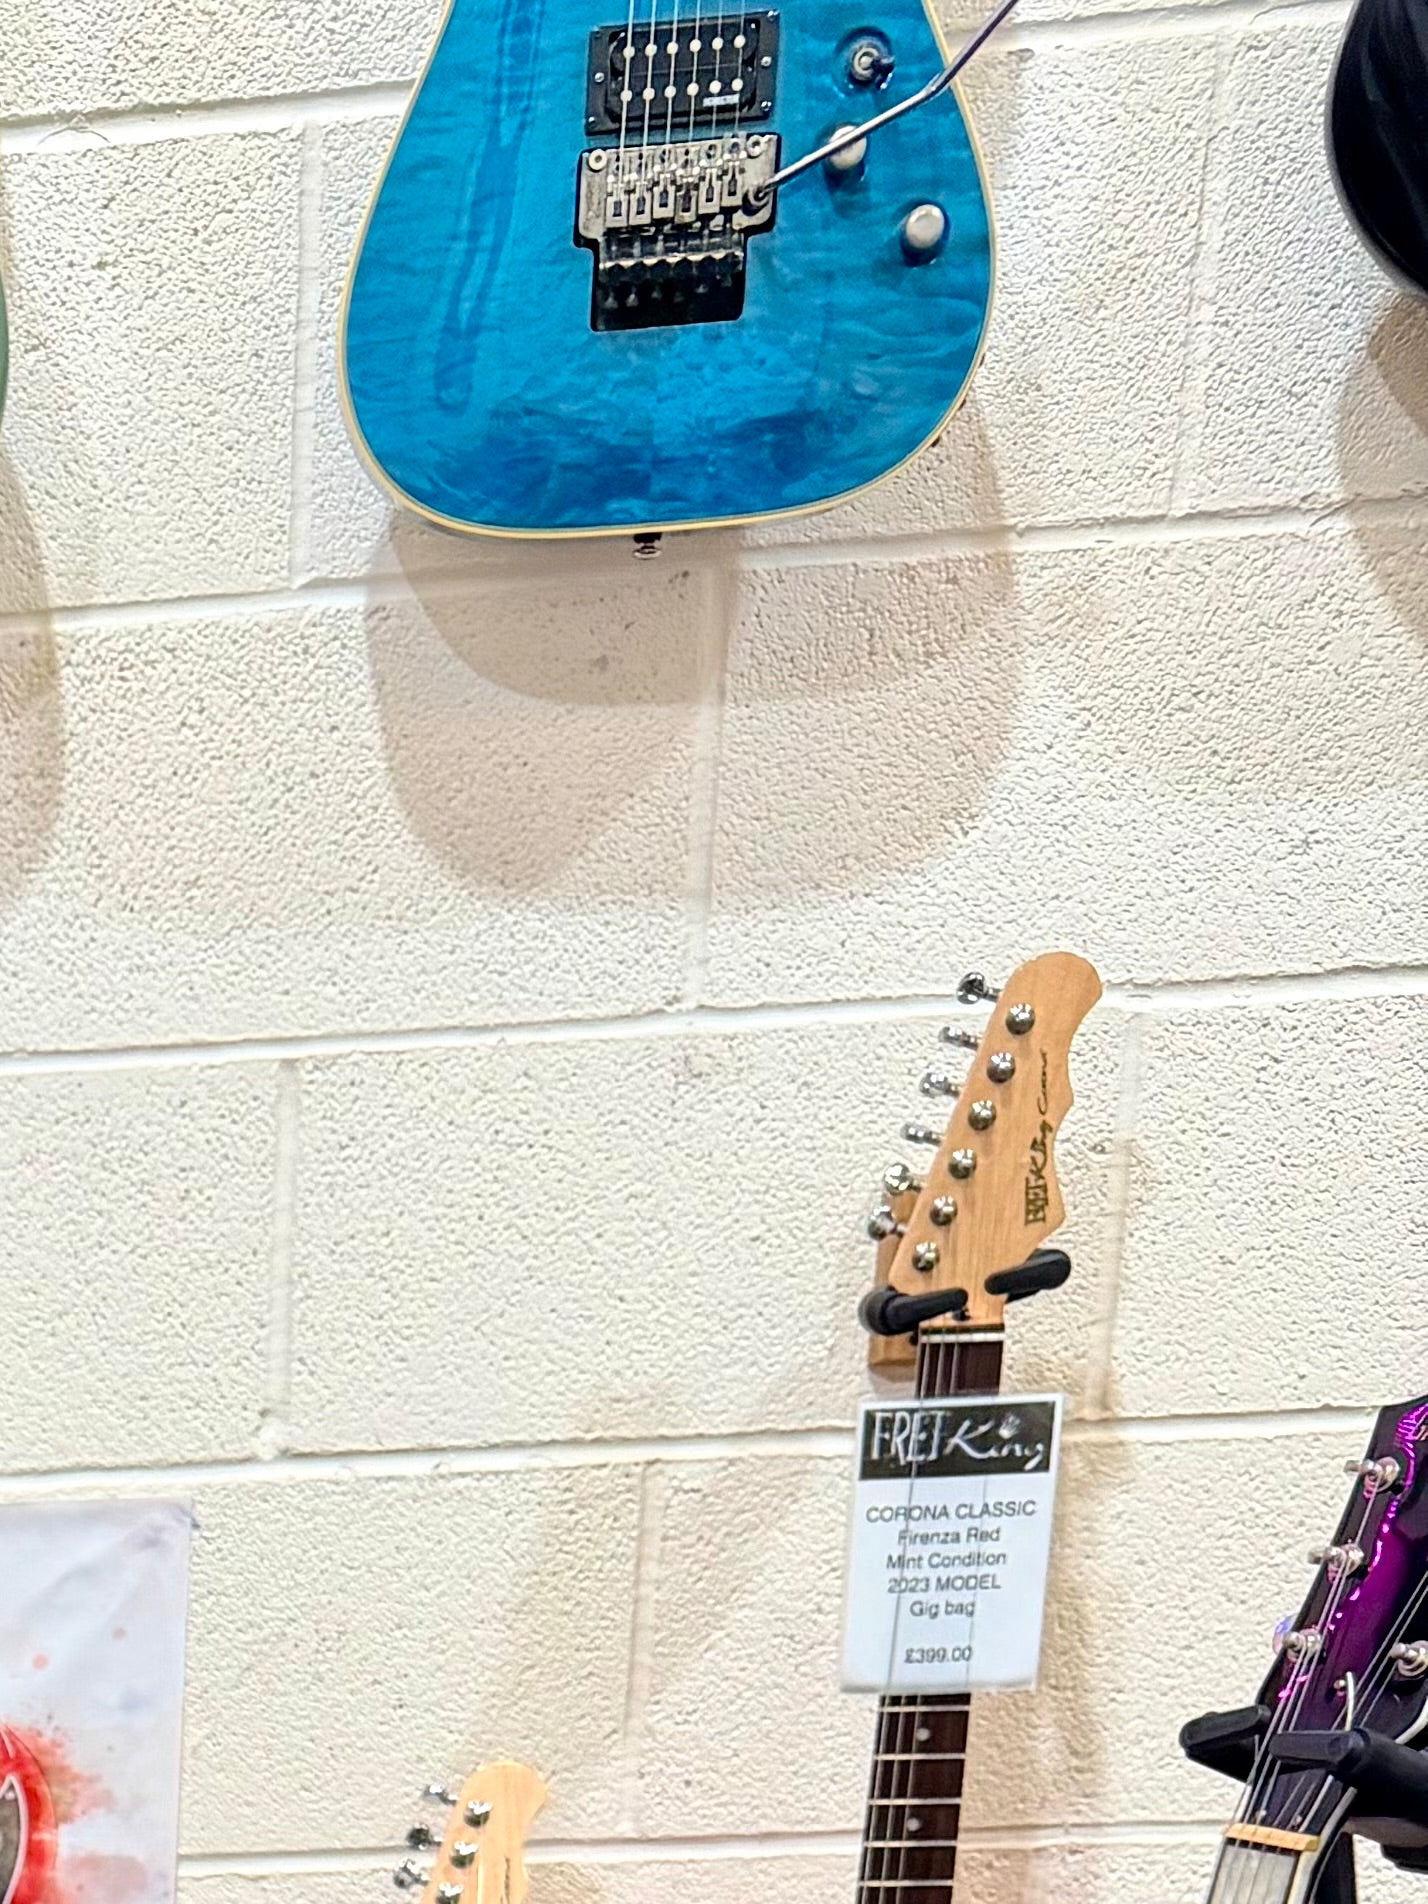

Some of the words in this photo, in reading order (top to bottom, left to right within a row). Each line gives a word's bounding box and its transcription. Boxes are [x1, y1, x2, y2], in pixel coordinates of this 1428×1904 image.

[866, 1505, 949, 1523] CORONA
[955, 1500, 1037, 1520] CLASSIC
[897, 1529, 961, 1545] Firenza
[966, 1527, 1001, 1543] Red
[886, 1554, 923, 1570] Mint
[928, 1552, 1006, 1569] Condition
[887, 1578, 930, 1594] 2023
[935, 1575, 1001, 1591] MODEL
[909, 1601, 940, 1619] Gig
[944, 1600, 976, 1617] bag
